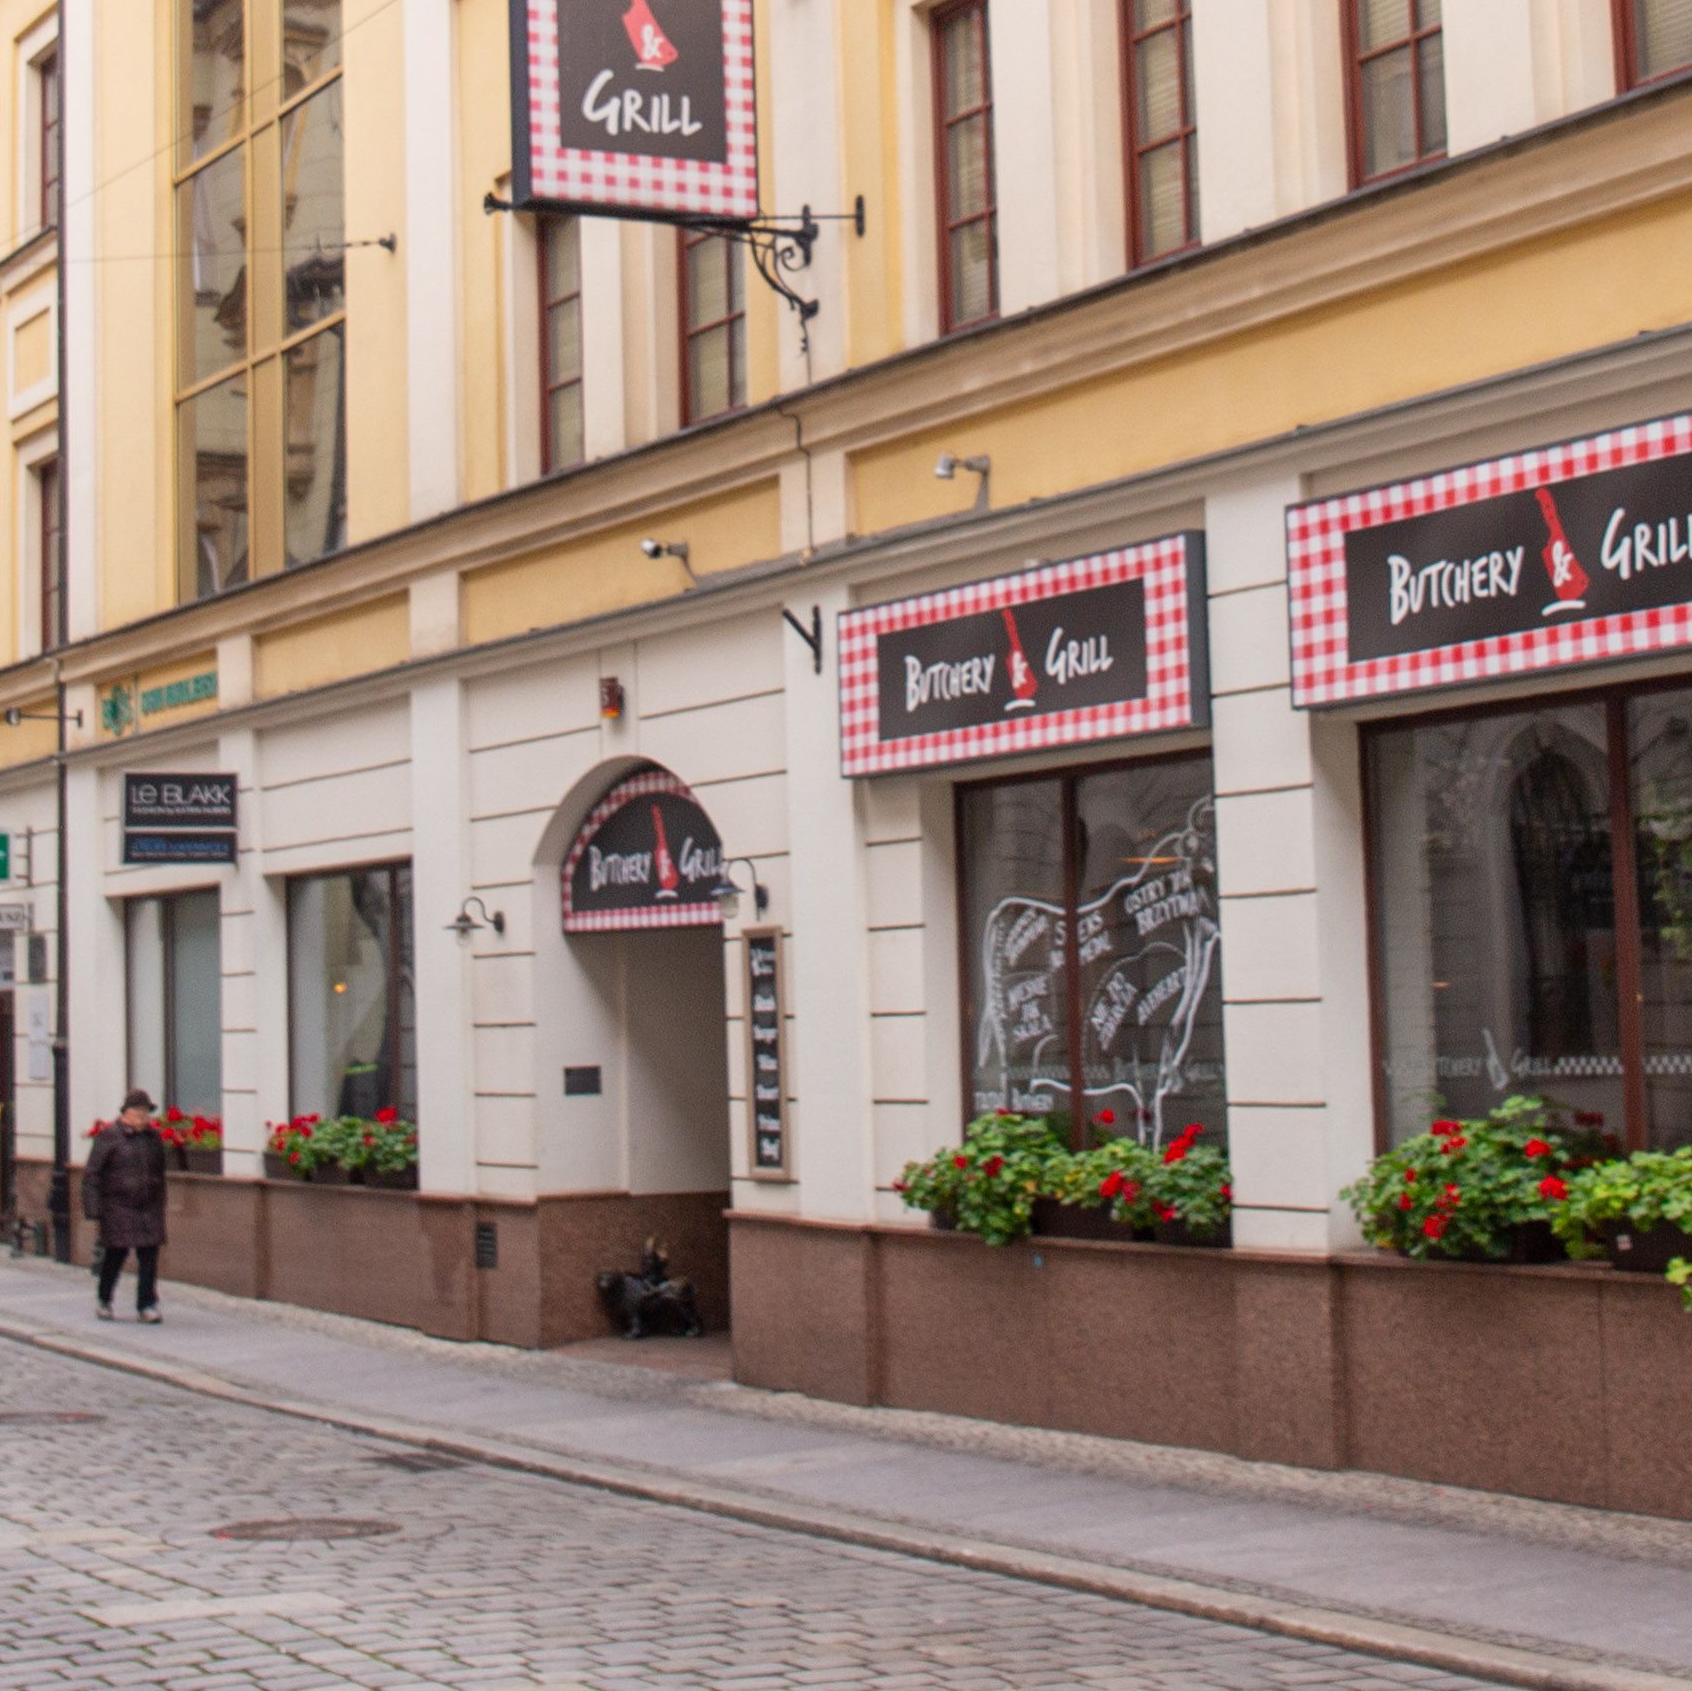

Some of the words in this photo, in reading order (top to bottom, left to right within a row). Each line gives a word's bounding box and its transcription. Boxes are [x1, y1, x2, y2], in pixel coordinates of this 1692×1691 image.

[639, 24, 664, 59] &
[581, 69, 703, 136] GRILL
[1387, 545, 1525, 626] BUTCHERY
[904, 655, 996, 712] BUTCHERY
[1045, 626, 1114, 685] GRILL
[162, 783, 231, 804] BLAKK
